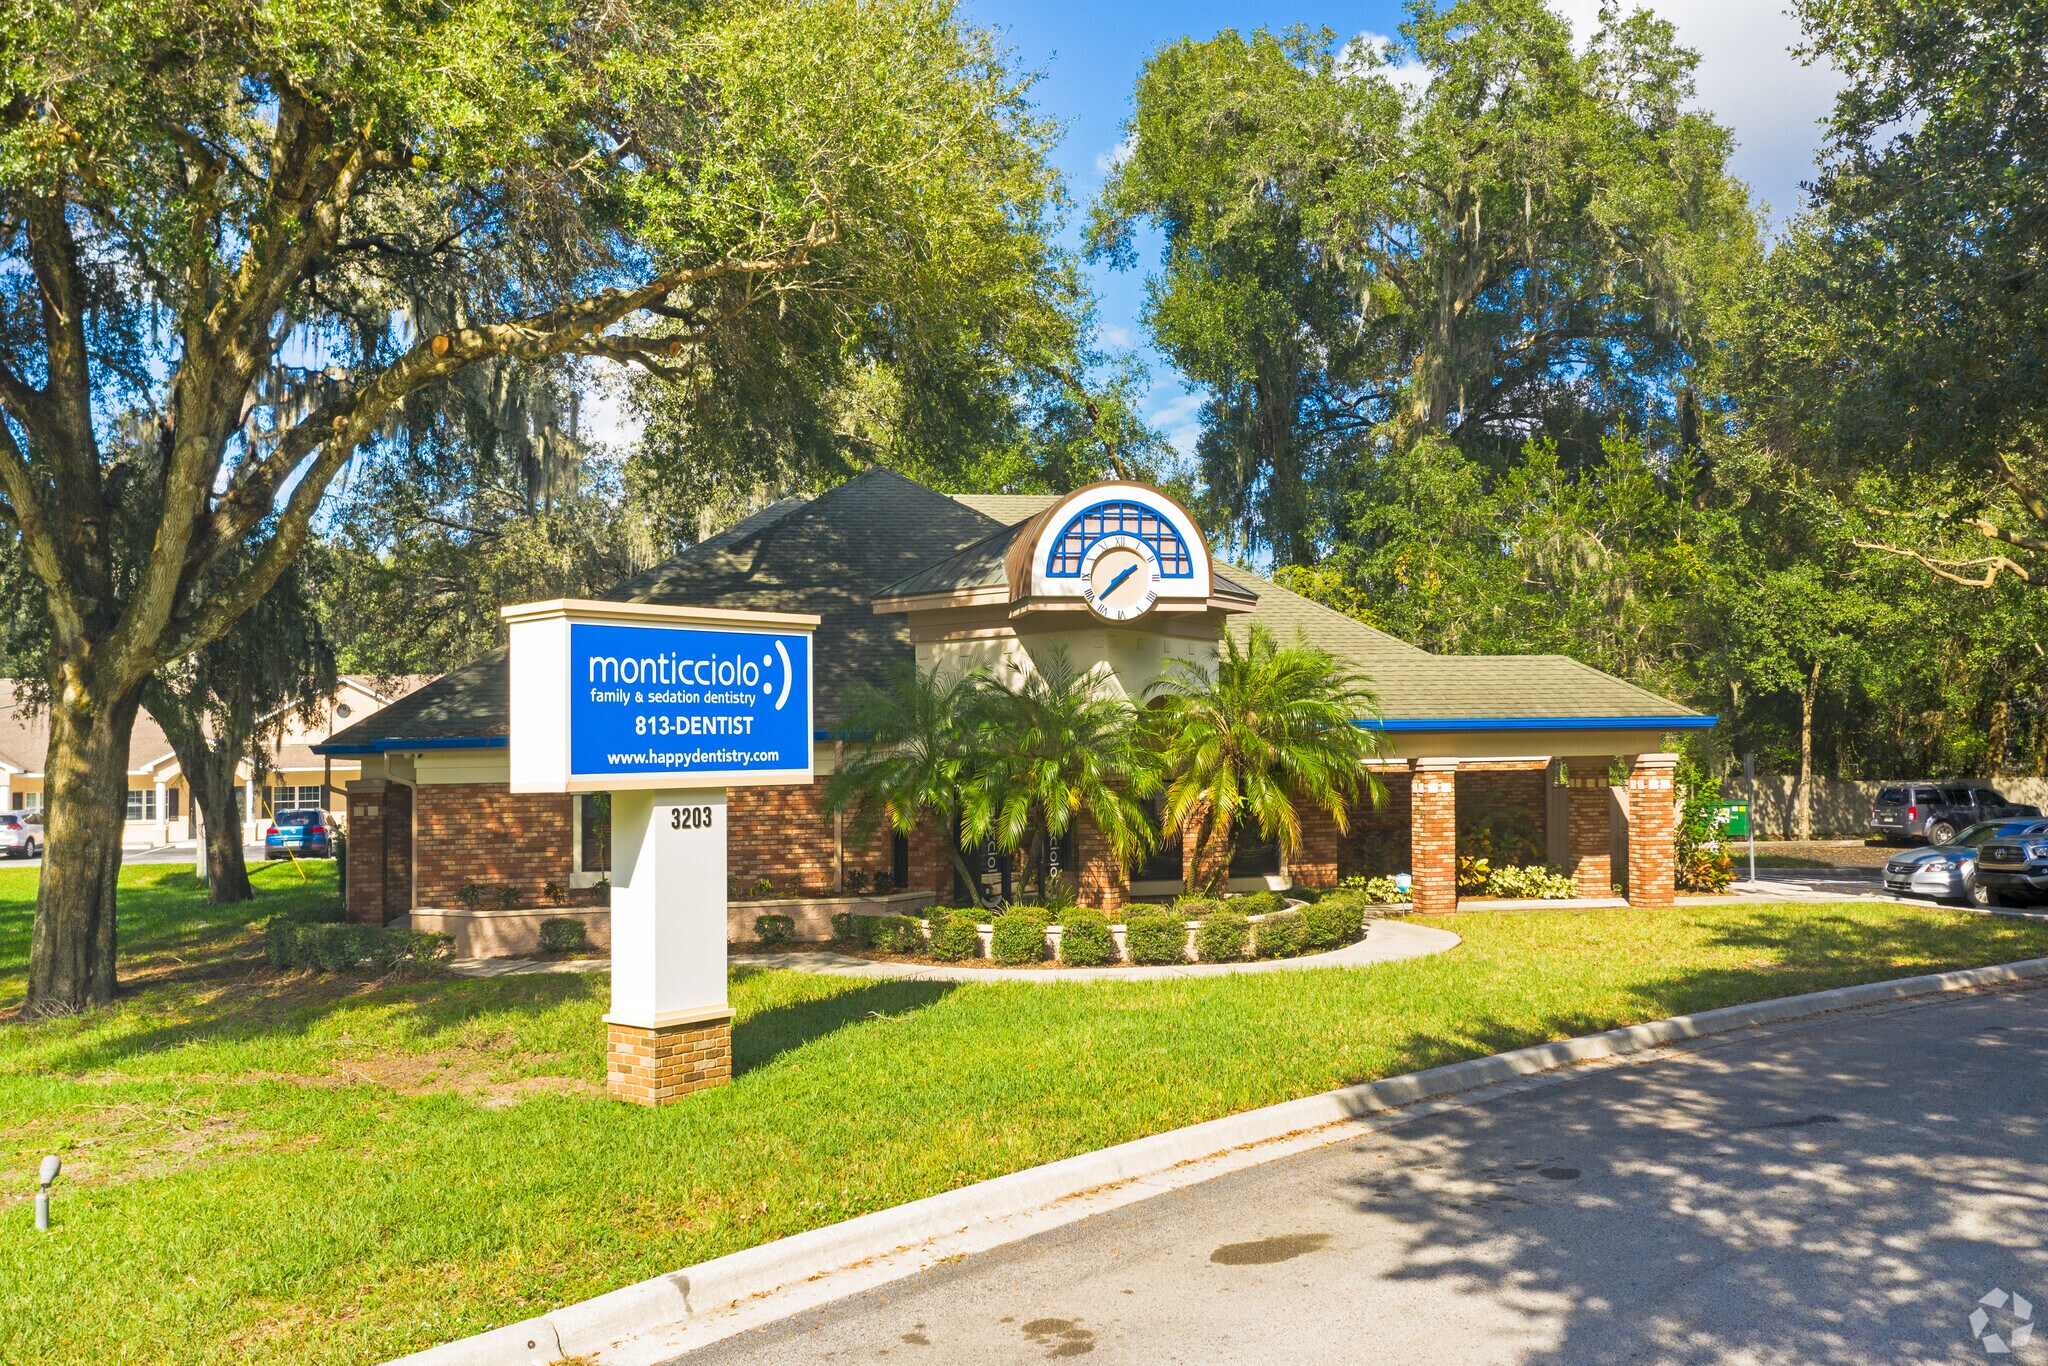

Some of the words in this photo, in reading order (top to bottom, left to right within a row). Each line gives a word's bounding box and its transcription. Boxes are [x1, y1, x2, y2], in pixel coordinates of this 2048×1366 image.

[590, 652, 760, 687] monticciolo
[590, 688, 631, 707] family
[635, 692, 644, 703] &
[648, 690, 700, 704] sedation
[704, 690, 756, 707] dentistry
[635, 716, 754, 735] 813-DENTIST
[607, 748, 780, 768] www.happydentistry.com
[671, 807, 712, 830] 3203
